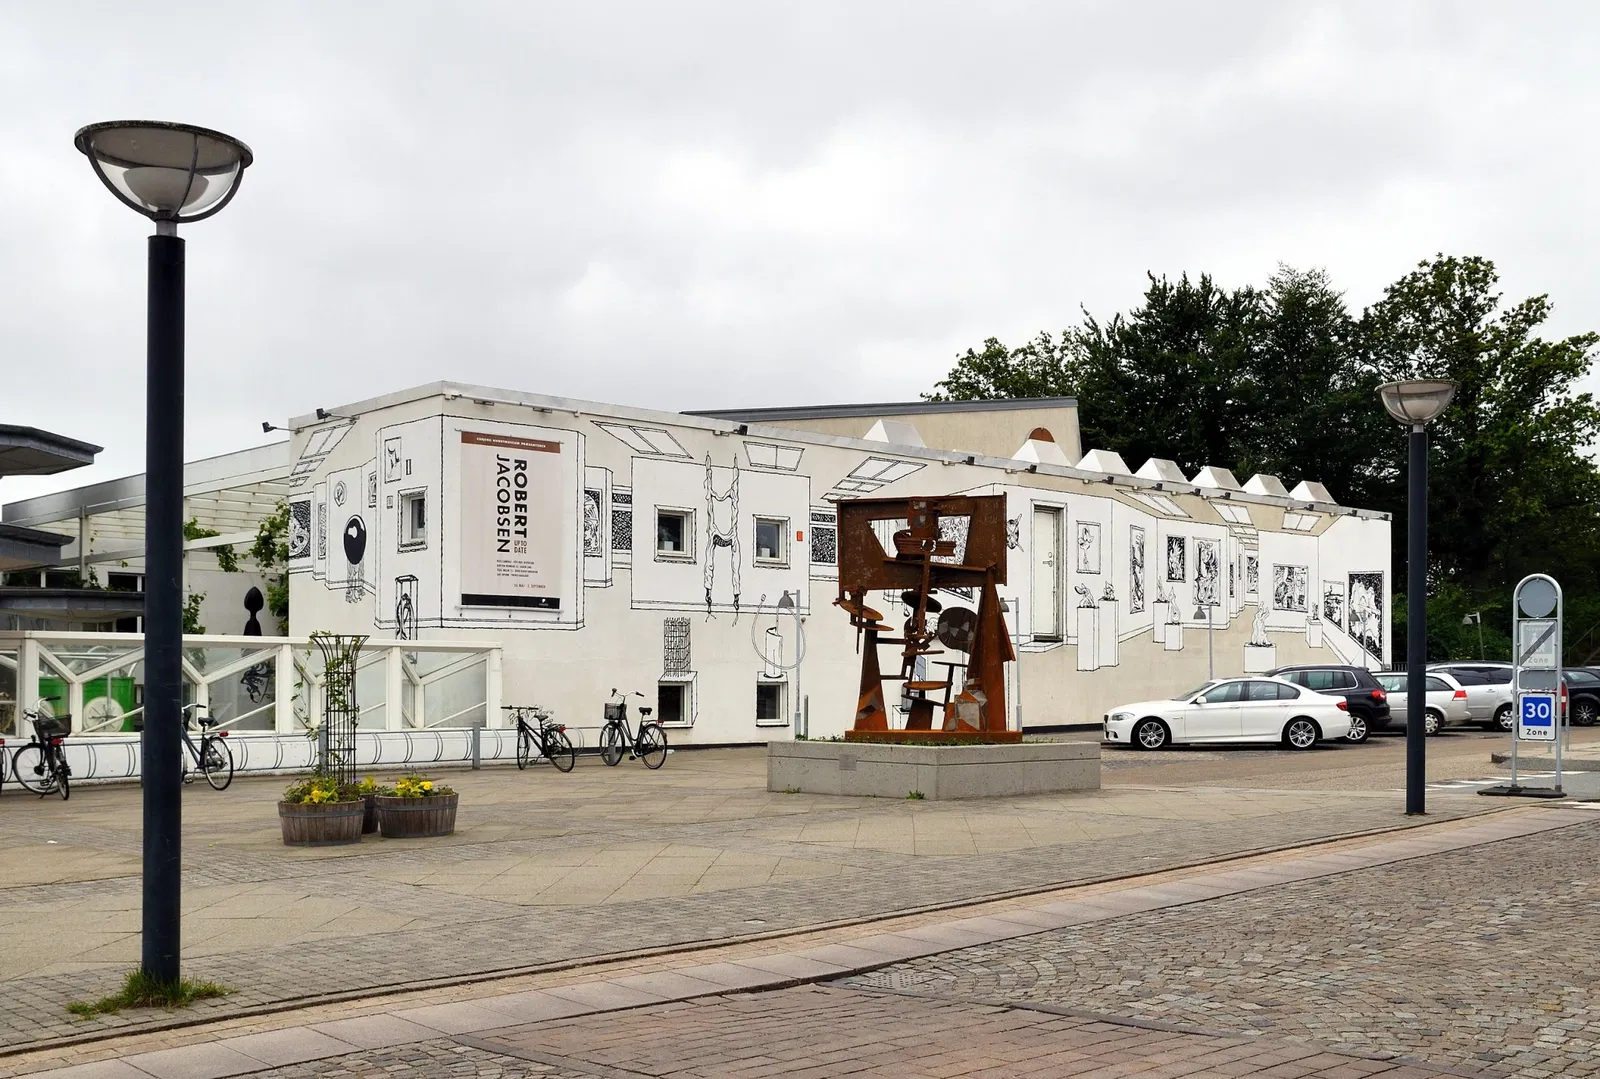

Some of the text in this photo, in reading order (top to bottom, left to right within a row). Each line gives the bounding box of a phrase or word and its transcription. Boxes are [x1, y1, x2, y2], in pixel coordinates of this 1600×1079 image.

[496, 454, 510, 552] JACOBSEN
[514, 459, 527, 538] ROBERT
[1525, 703, 1550, 719] 30
[1526, 728, 1548, 736] Zone
